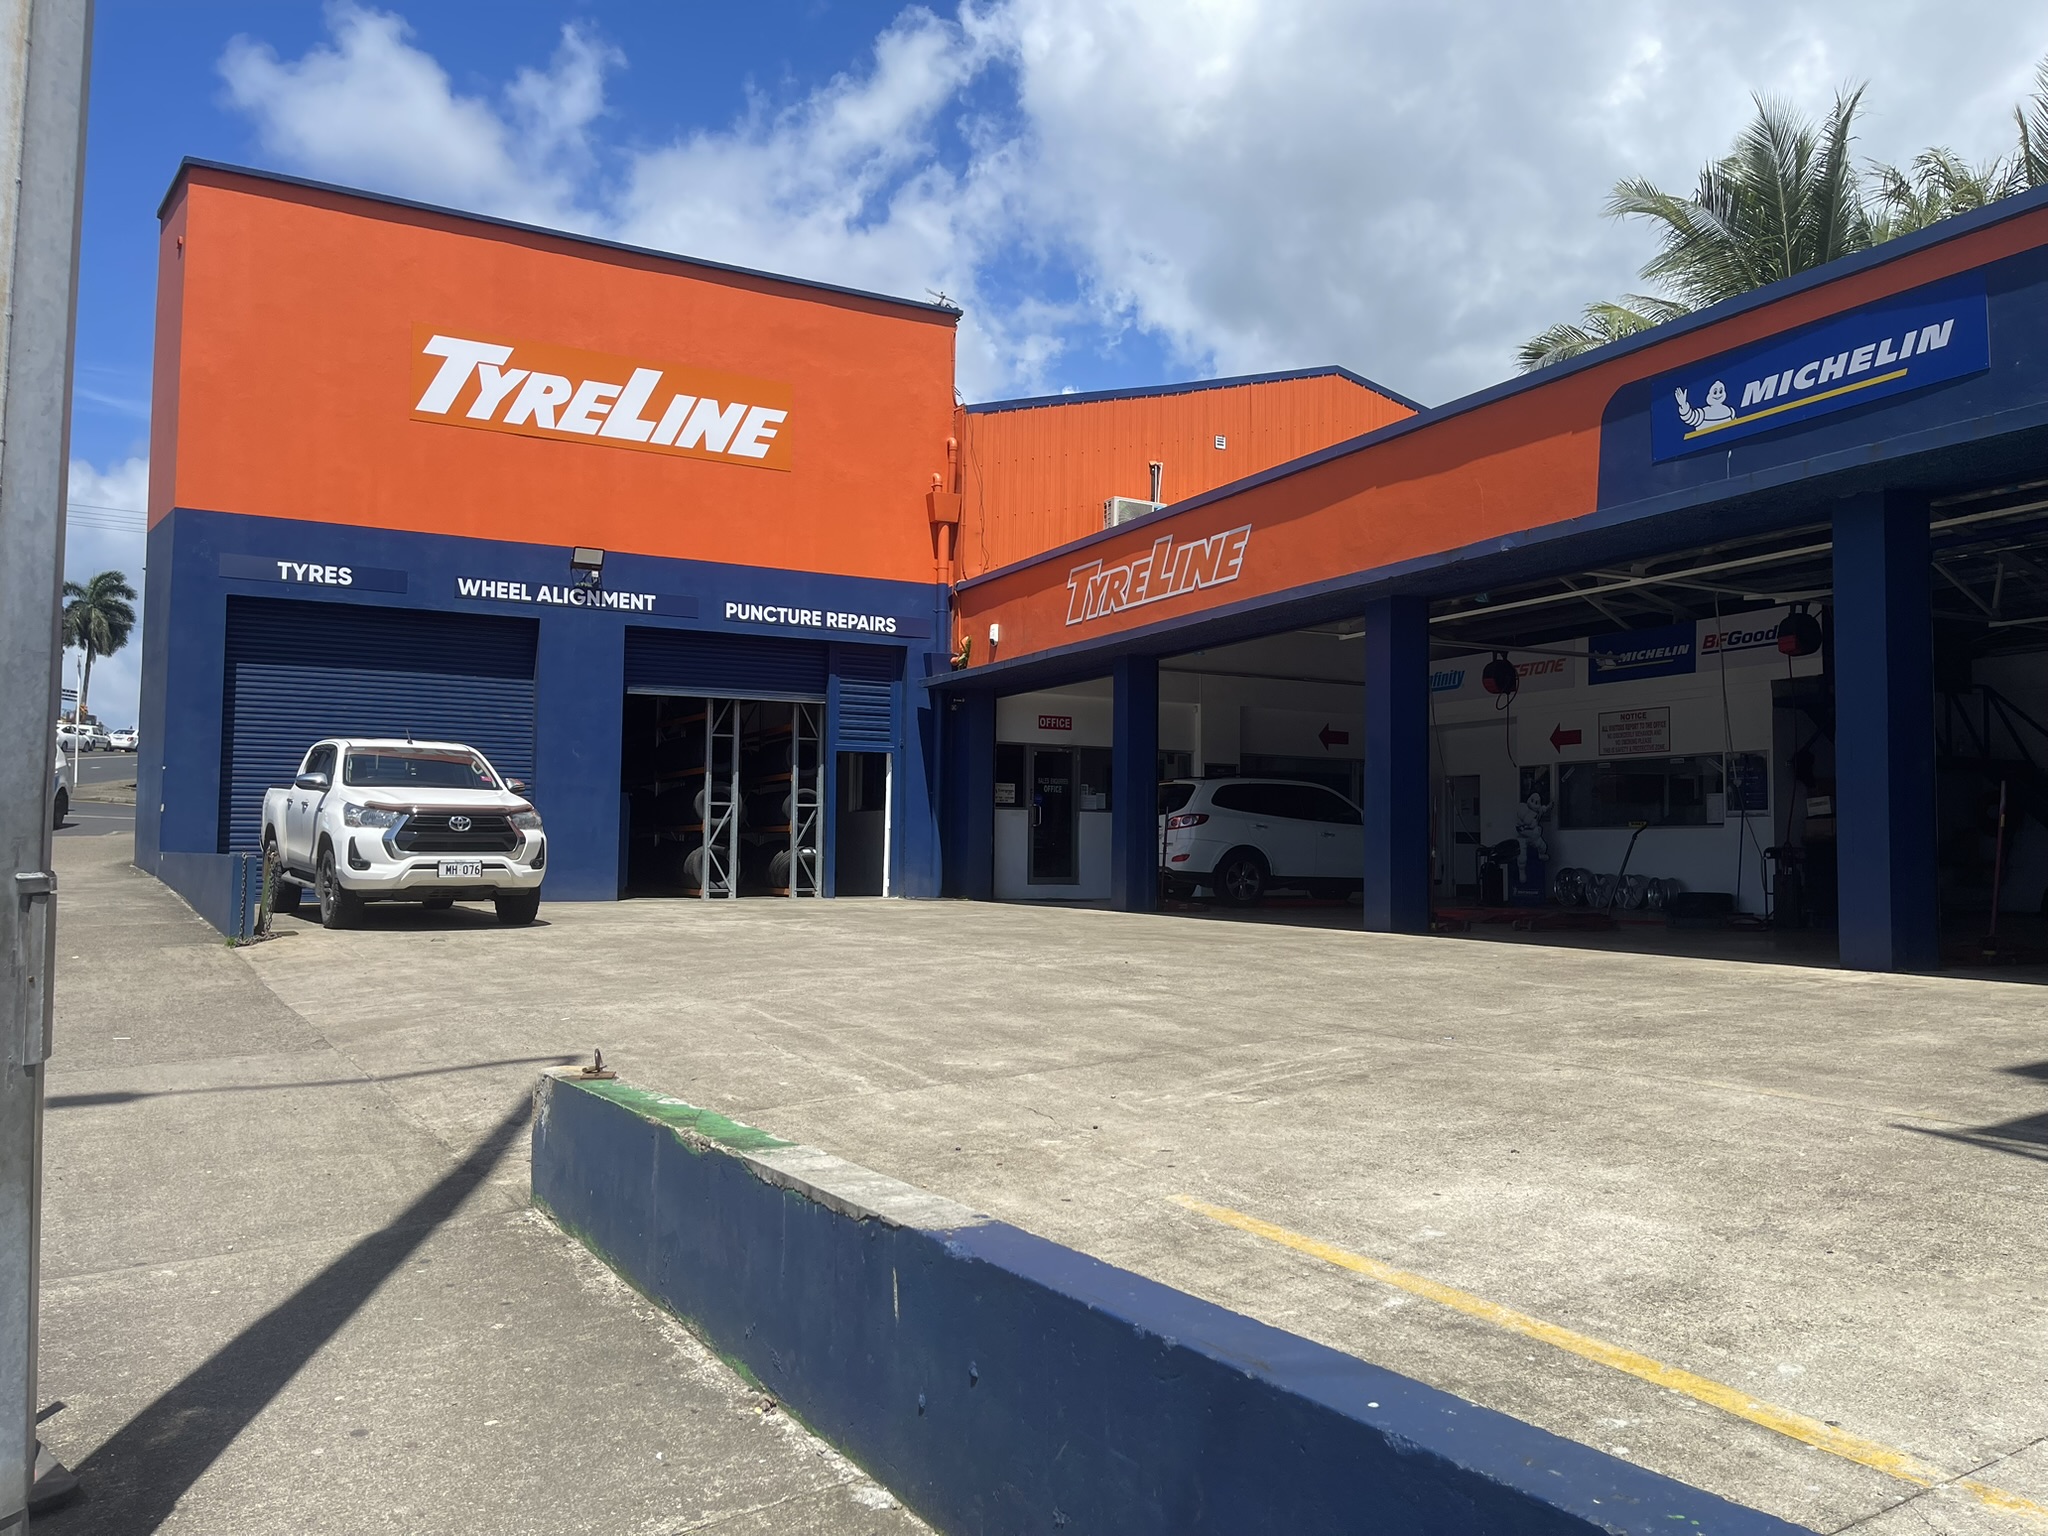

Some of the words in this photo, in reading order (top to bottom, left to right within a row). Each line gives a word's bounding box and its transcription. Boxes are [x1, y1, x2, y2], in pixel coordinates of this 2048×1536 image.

[1740, 319, 1955, 408] MICHELIN
[277, 561, 353, 586] TYRES
[457, 577, 532, 601] WHEEL
[536, 585, 657, 611] ALIGNMENT
[725, 602, 822, 626] PUNCTURE
[826, 612, 897, 633] REPAIRS
[1702, 625, 1780, 649] BFGood
[1617, 644, 1690, 663] MICHELIN
[1040, 717, 1070, 728] OFFICE
[1620, 712, 1647, 720] NOTICE
[1043, 784, 1063, 793] OFFICE
[446, 865, 458, 875] MH
[463, 865, 480, 875] 076
